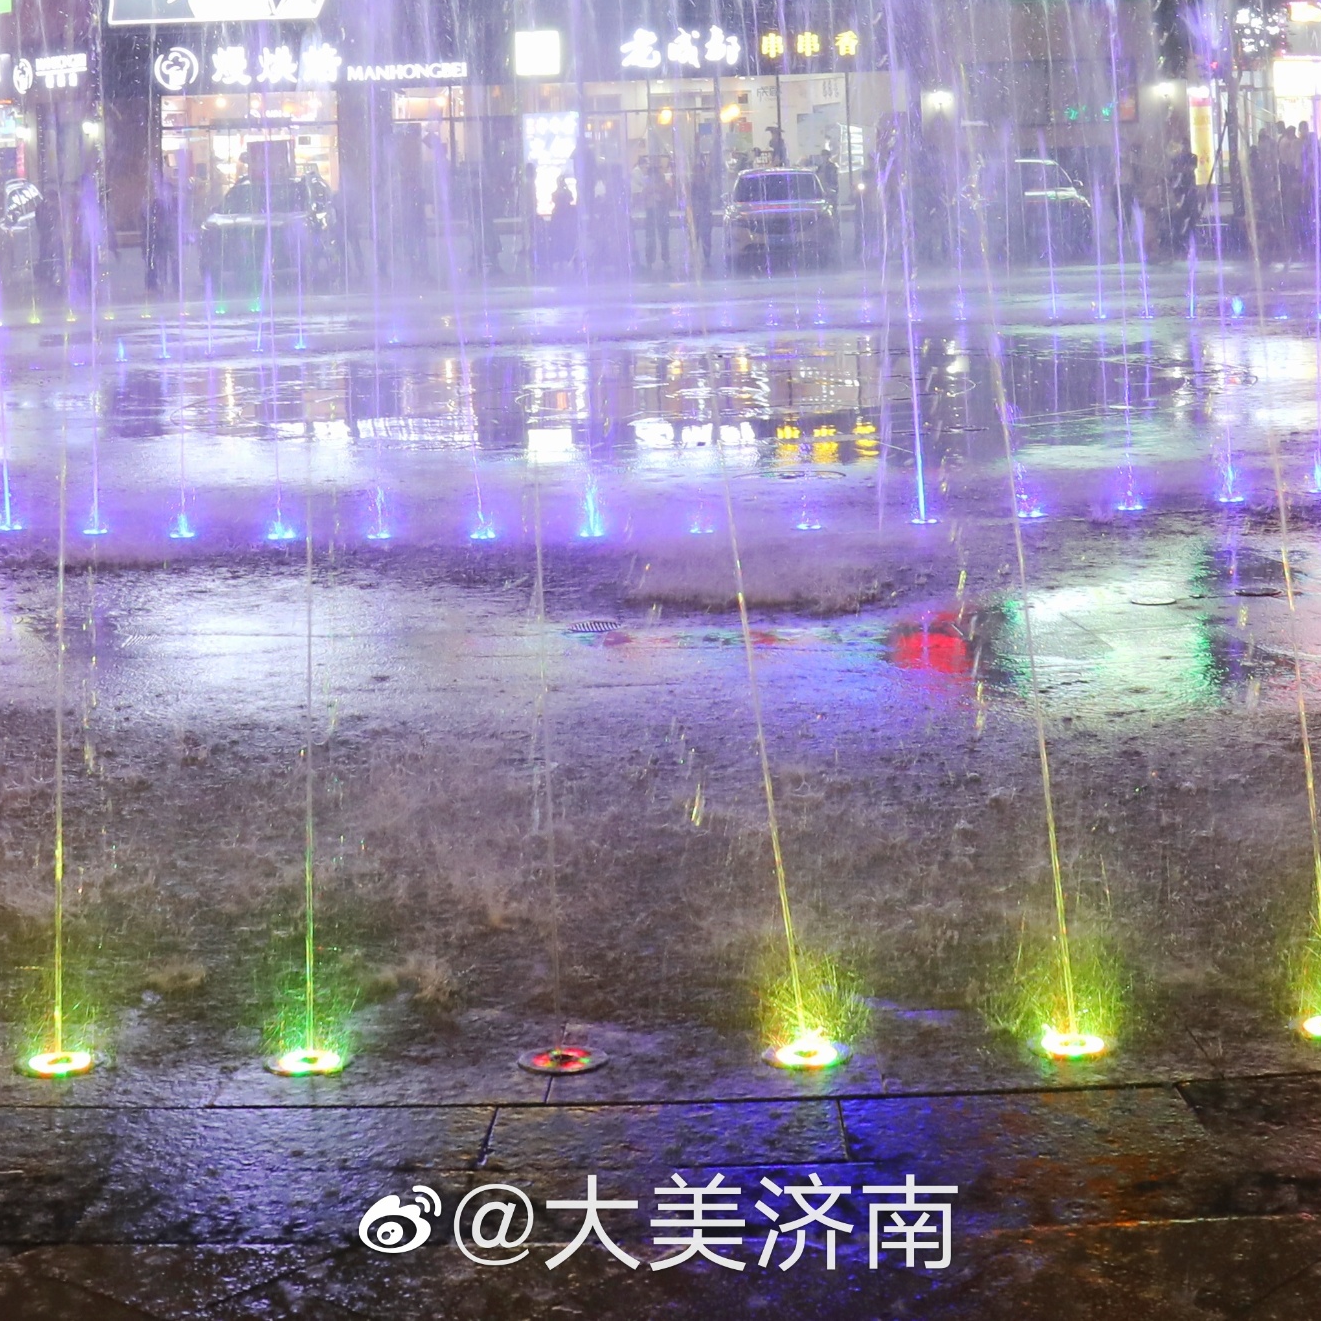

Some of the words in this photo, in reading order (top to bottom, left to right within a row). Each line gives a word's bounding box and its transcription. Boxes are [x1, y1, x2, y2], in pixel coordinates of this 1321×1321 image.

[761, 30, 859, 59] 串串香
[347, 61, 468, 81] MANHONGBEI
